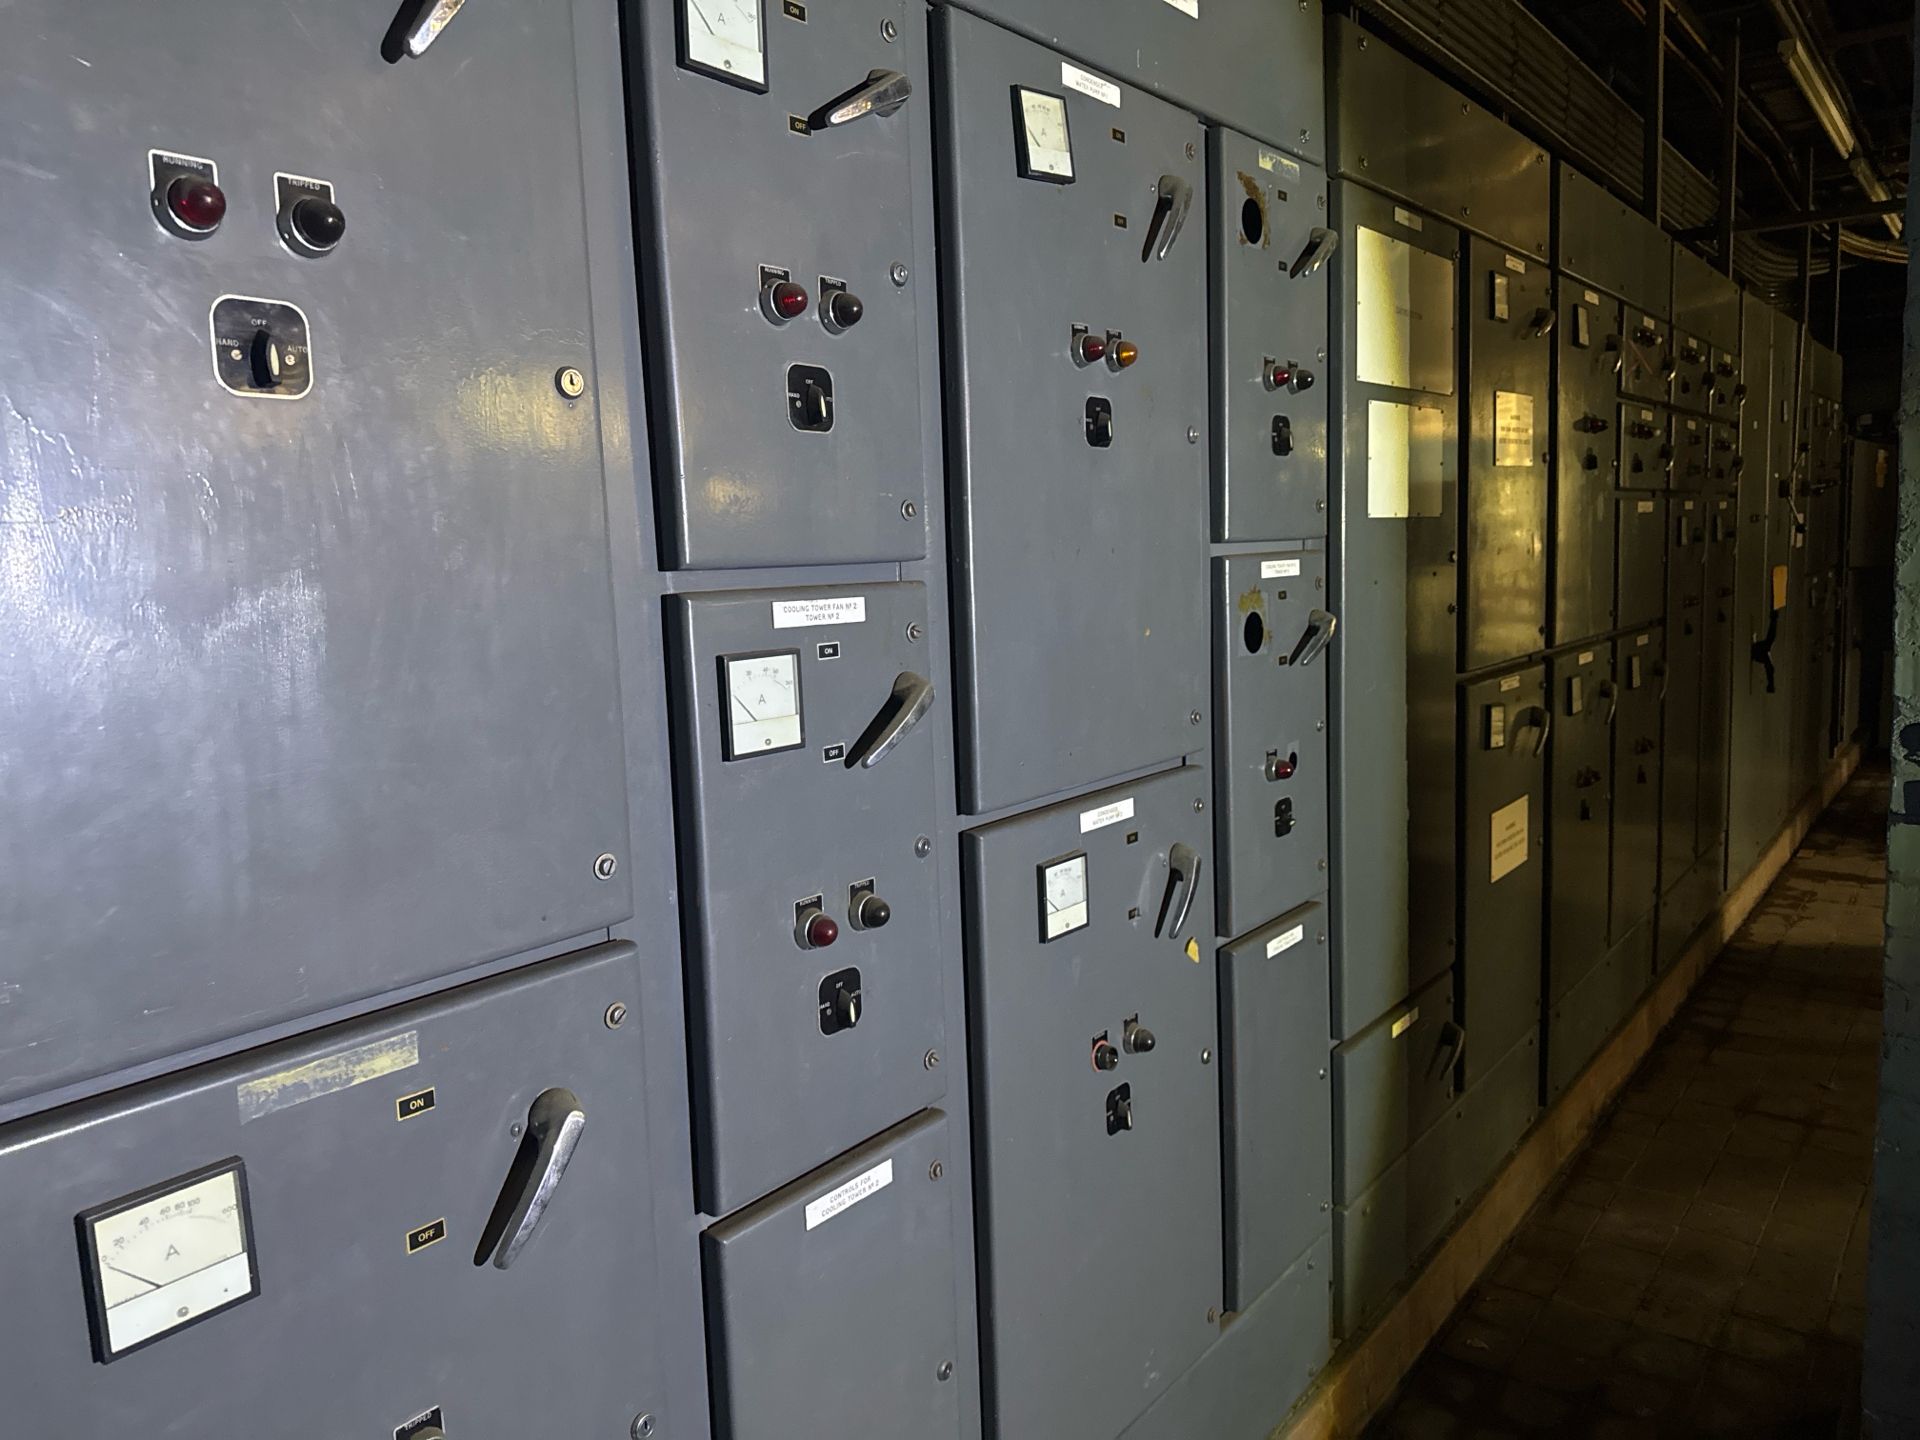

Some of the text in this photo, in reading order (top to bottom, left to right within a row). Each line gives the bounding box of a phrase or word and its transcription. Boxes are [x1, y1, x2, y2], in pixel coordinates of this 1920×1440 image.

[789, 6, 800, 15] ON
[795, 121, 806, 130] OFF
[162, 155, 204, 171] RUNNING
[287, 177, 321, 192] TRIPPED
[250, 318, 268, 328] OFF
[214, 337, 240, 348] HAND
[286, 344, 309, 354] AUTO
[783, 604, 810, 614] COOLING
[811, 603, 831, 612] TOWER
[832, 602, 844, 611] FAN
[805, 613, 826, 622] TOWER
[824, 647, 833, 655] ON
[758, 693, 767, 705] A
[409, 1097, 424, 1110] ON
[829, 1175, 871, 1203] CONTROLS FOR
[187, 1197, 201, 1207] 100
[821, 1198, 847, 1218] COOLING
[847, 1186, 867, 1203] TOWER
[159, 1205, 171, 1216] 60
[221, 1203, 238, 1214] 600
[138, 1216, 150, 1226] 40
[417, 1228, 436, 1243] OFF
[112, 1236, 125, 1247] 20
[165, 1244, 181, 1261] A
[404, 1411, 432, 1431] TRIPPED
